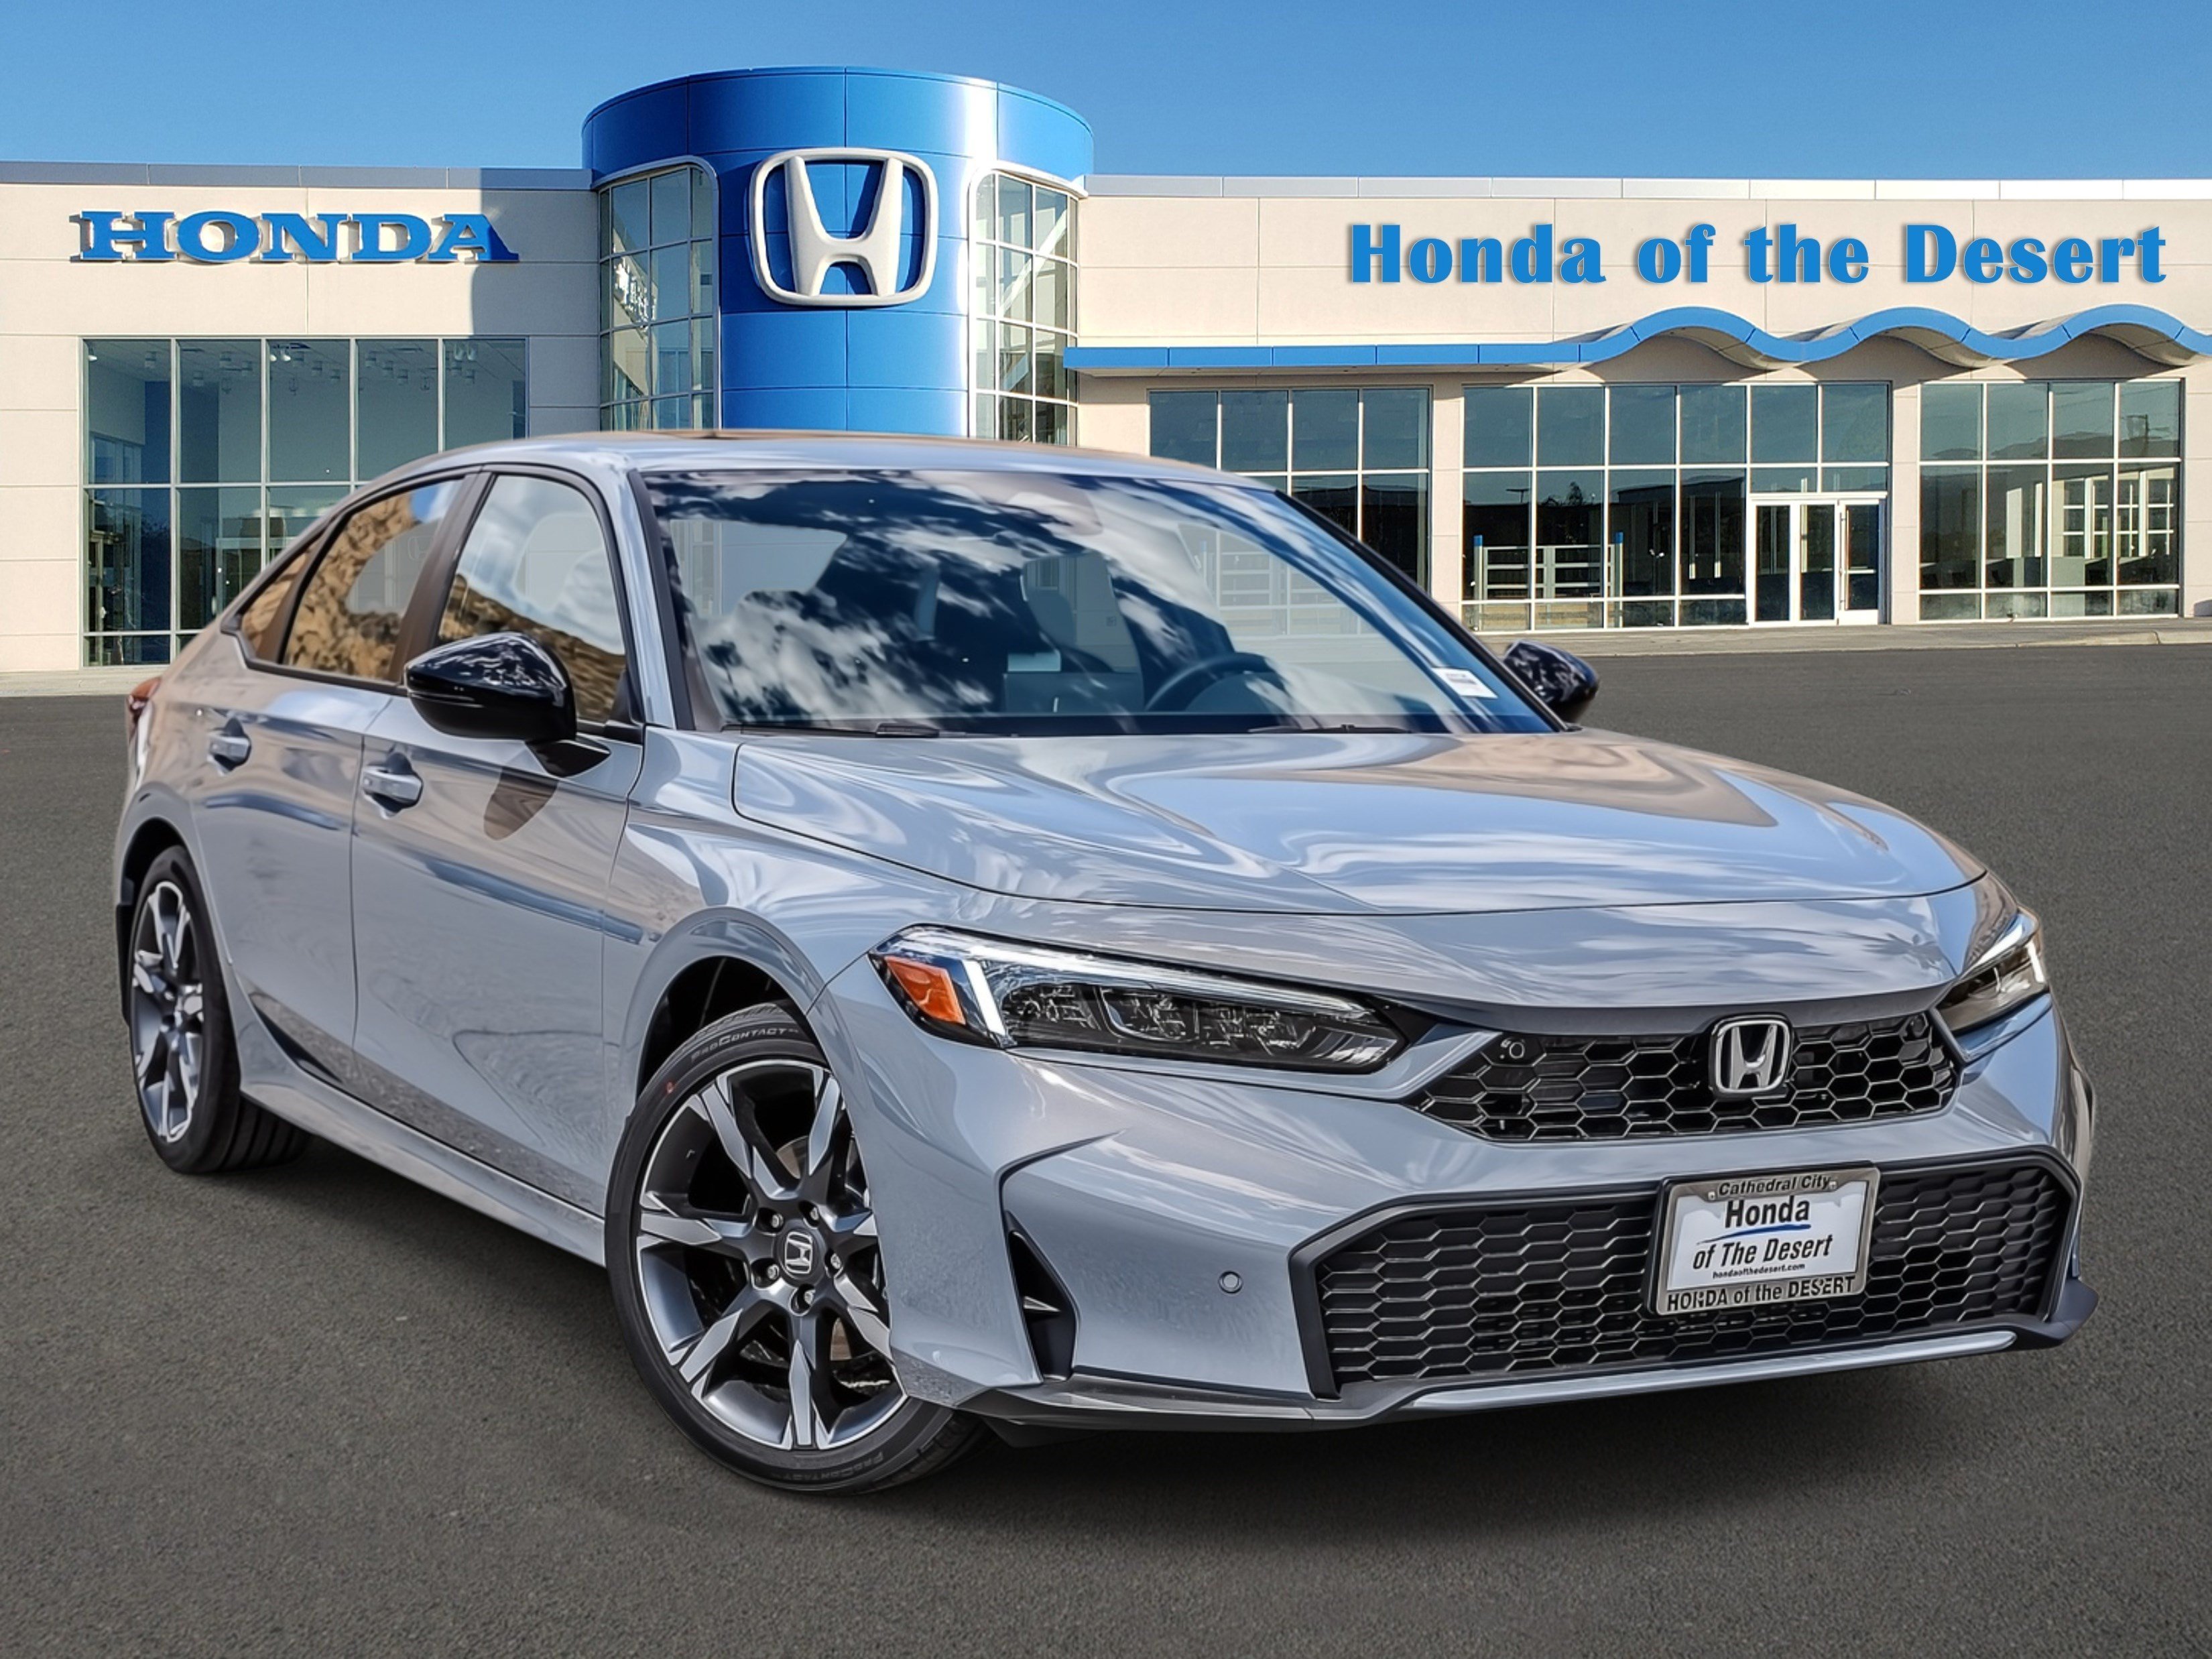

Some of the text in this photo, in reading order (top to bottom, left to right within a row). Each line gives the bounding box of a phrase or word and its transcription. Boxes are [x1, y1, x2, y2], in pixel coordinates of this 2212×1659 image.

[80, 210, 519, 262] HONDA
[1352, 224, 2166, 283] Honda of the Desert
[1719, 1174, 1831, 1196] Cathedral City
[1725, 1195, 1810, 1228] Honda
[1693, 1234, 1833, 1270] of The Desert
[1713, 1264, 1805, 1279] hondaofthedesert.com
[1667, 1275, 1855, 1312] HONDA of the DESERT
